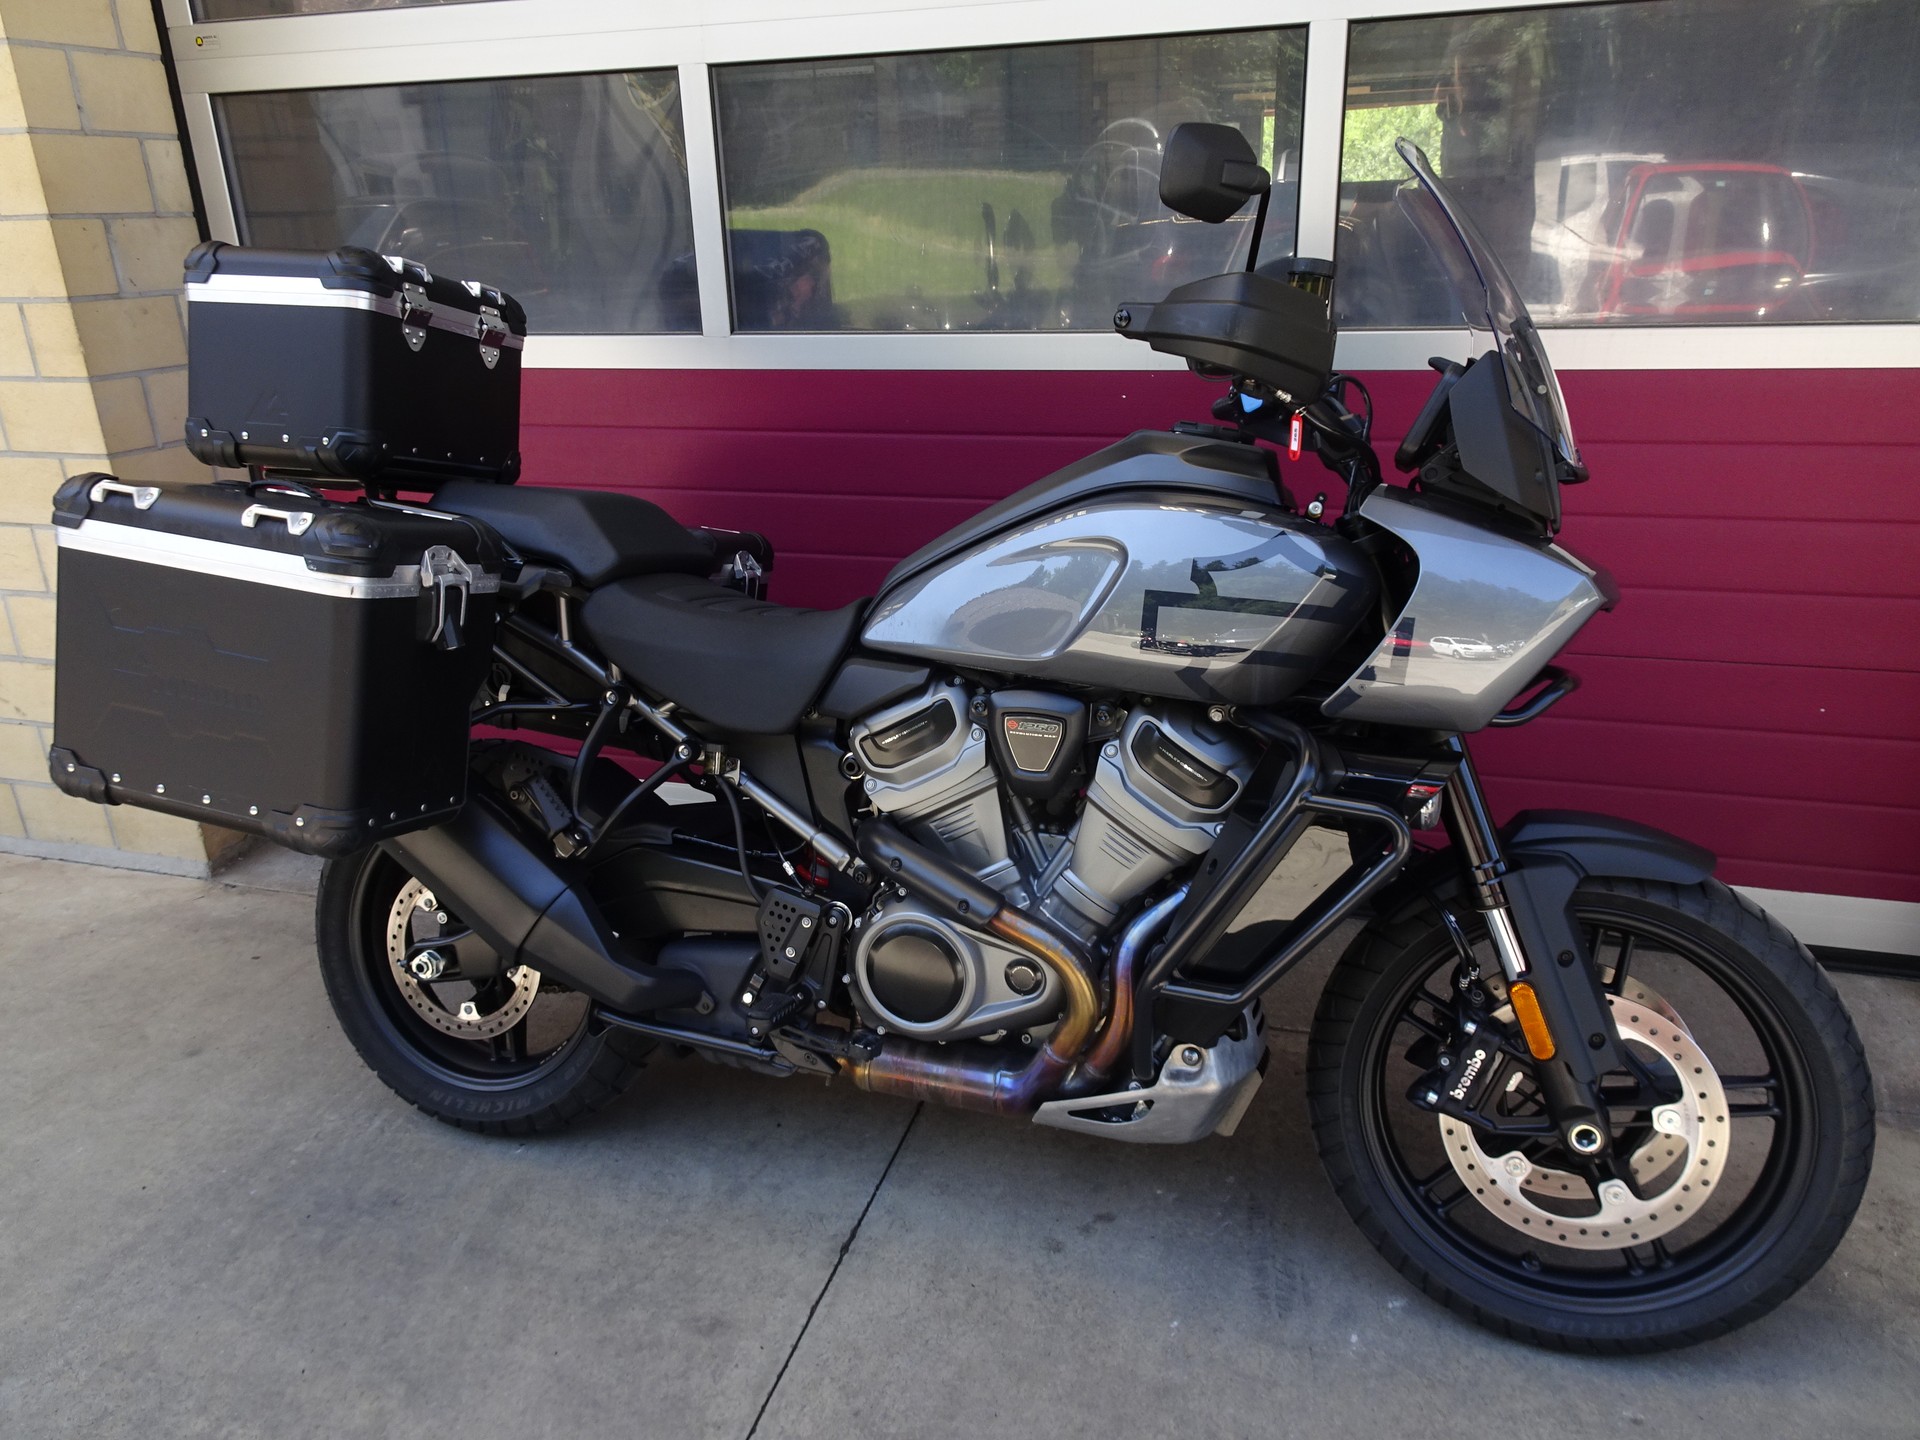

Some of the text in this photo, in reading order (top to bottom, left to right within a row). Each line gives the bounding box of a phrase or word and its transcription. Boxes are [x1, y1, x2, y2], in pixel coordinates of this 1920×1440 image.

[1018, 721, 1059, 733] 1250
[1449, 1049, 1487, 1101] brembo
[428, 1089, 532, 1115] MICHELIN
